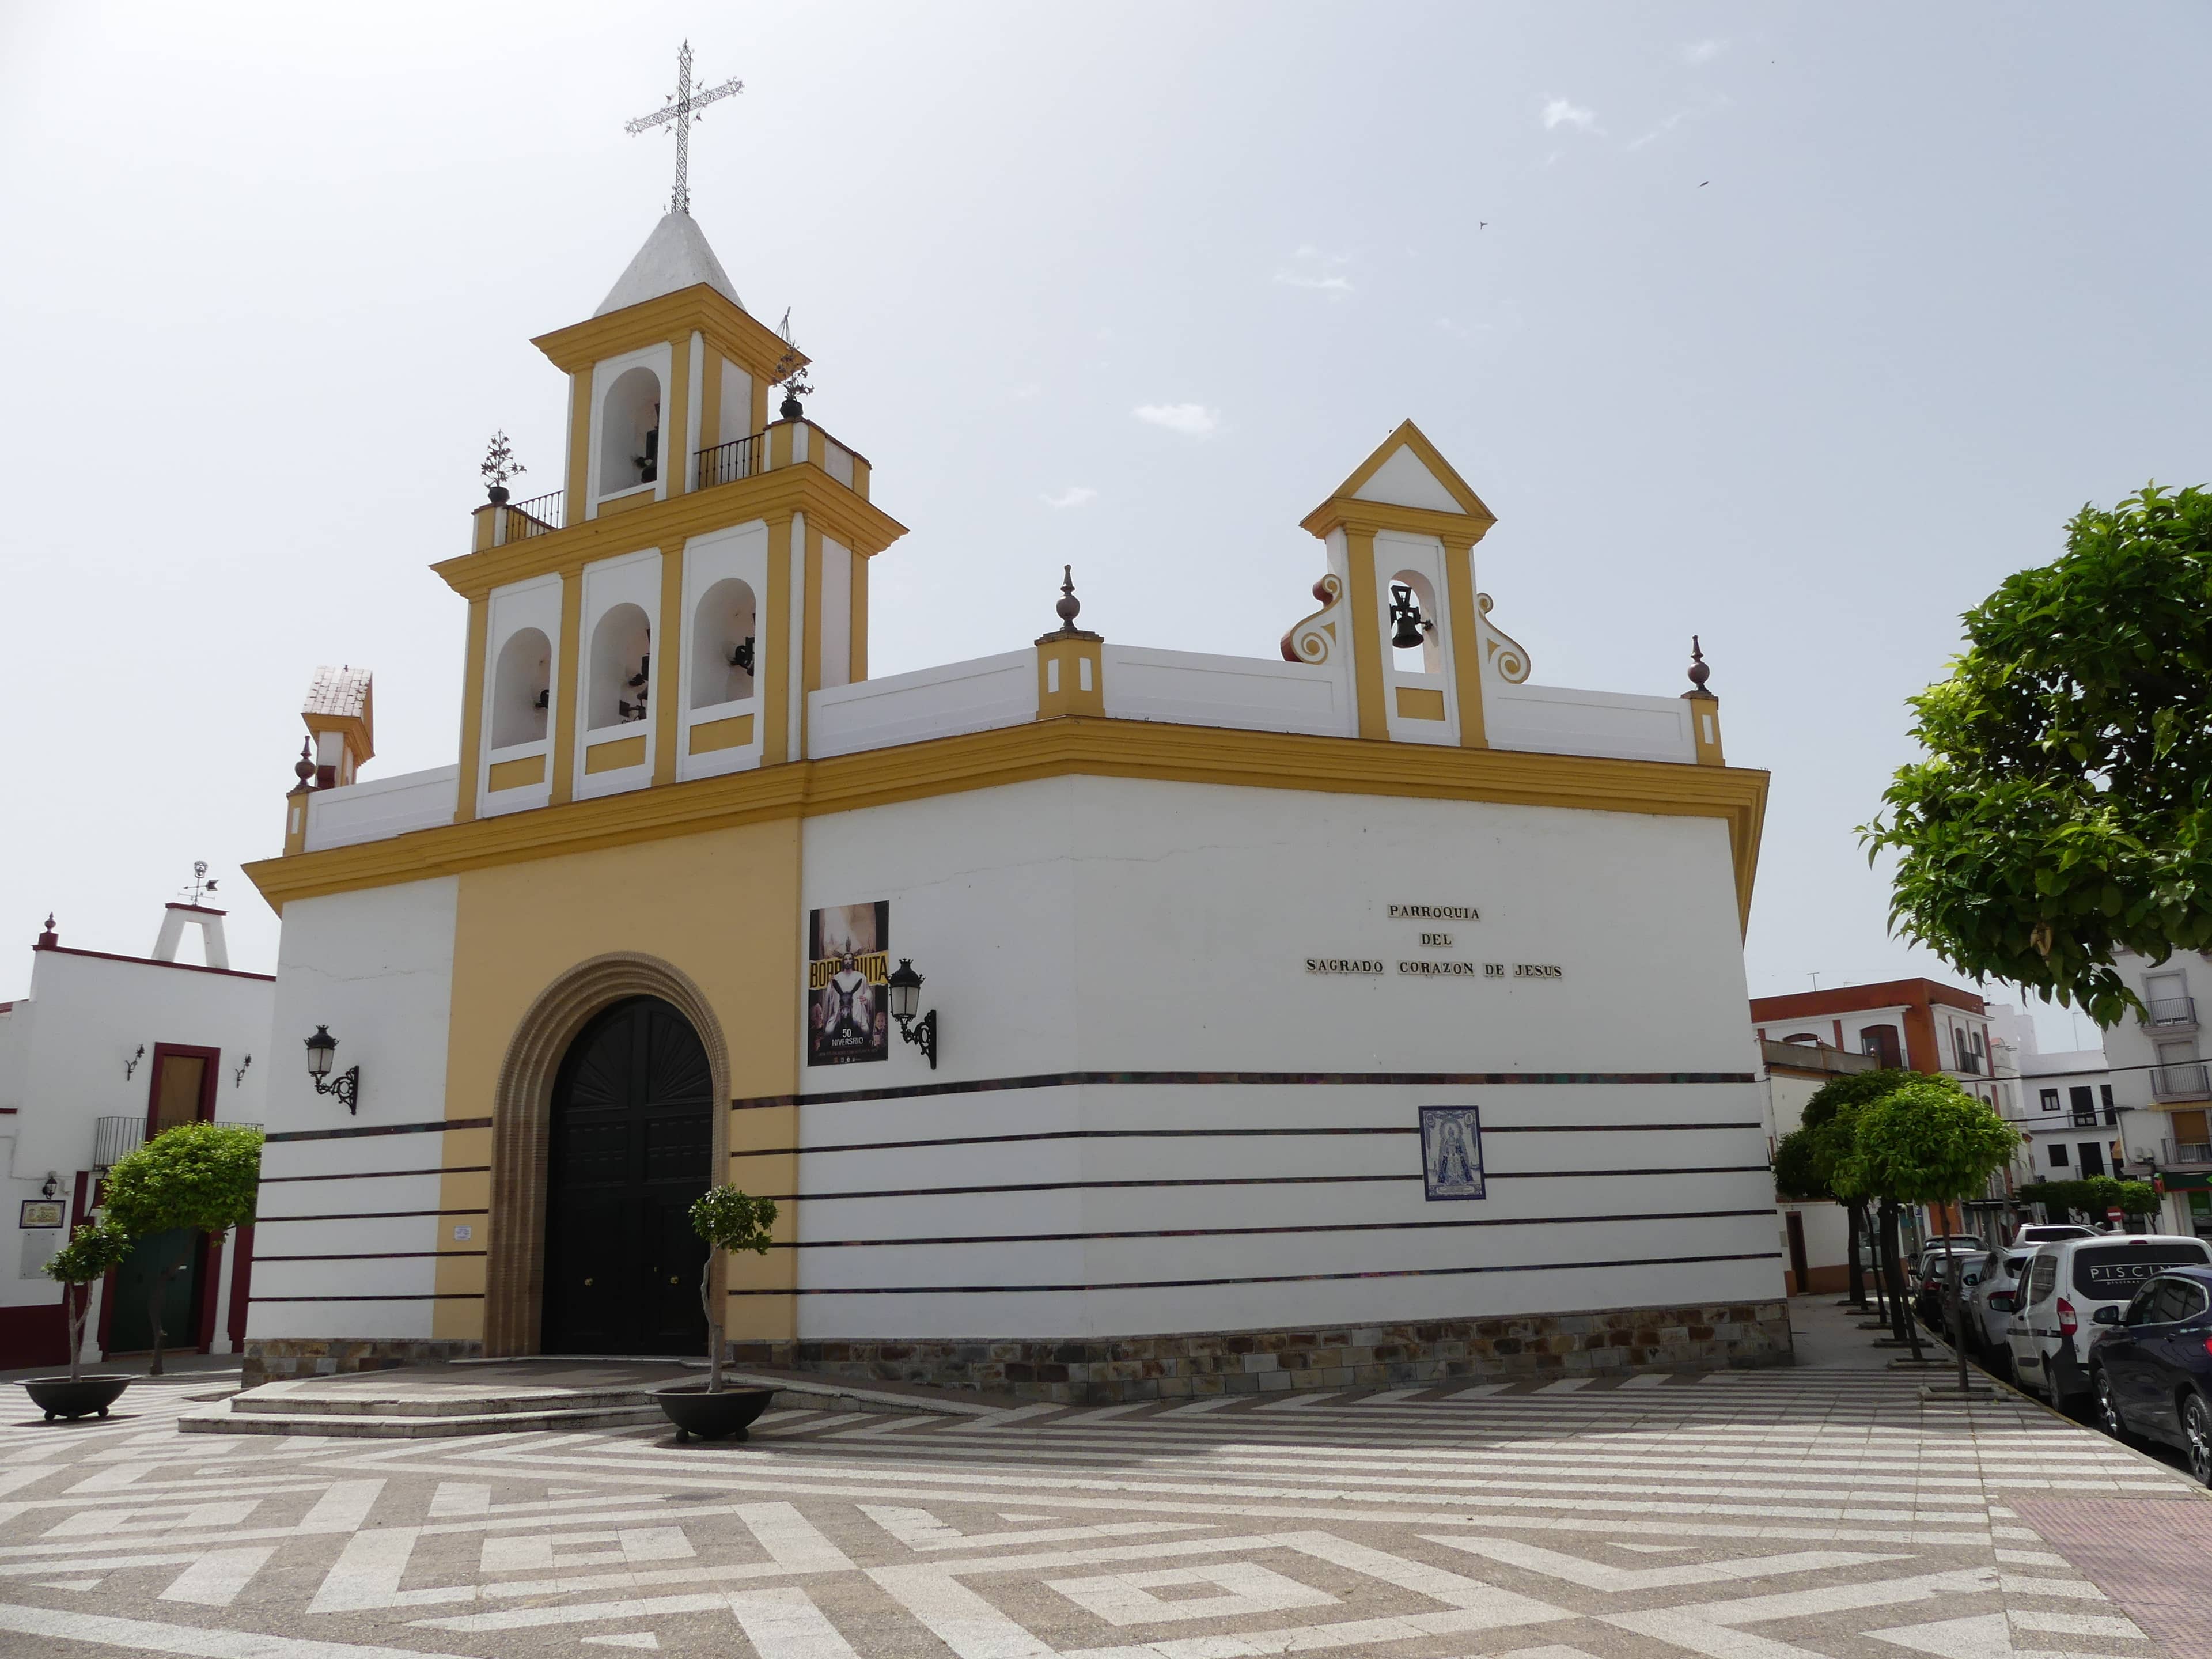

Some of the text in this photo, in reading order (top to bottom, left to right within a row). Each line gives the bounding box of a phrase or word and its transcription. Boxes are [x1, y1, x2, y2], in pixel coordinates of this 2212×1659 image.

[1389, 905, 1479, 920] PARROQUIA
[1422, 934, 1452, 946] DEL
[1306, 959, 1562, 978] SAGRADO CORAZON DE JESUS
[842, 1028, 851, 1038] 50
